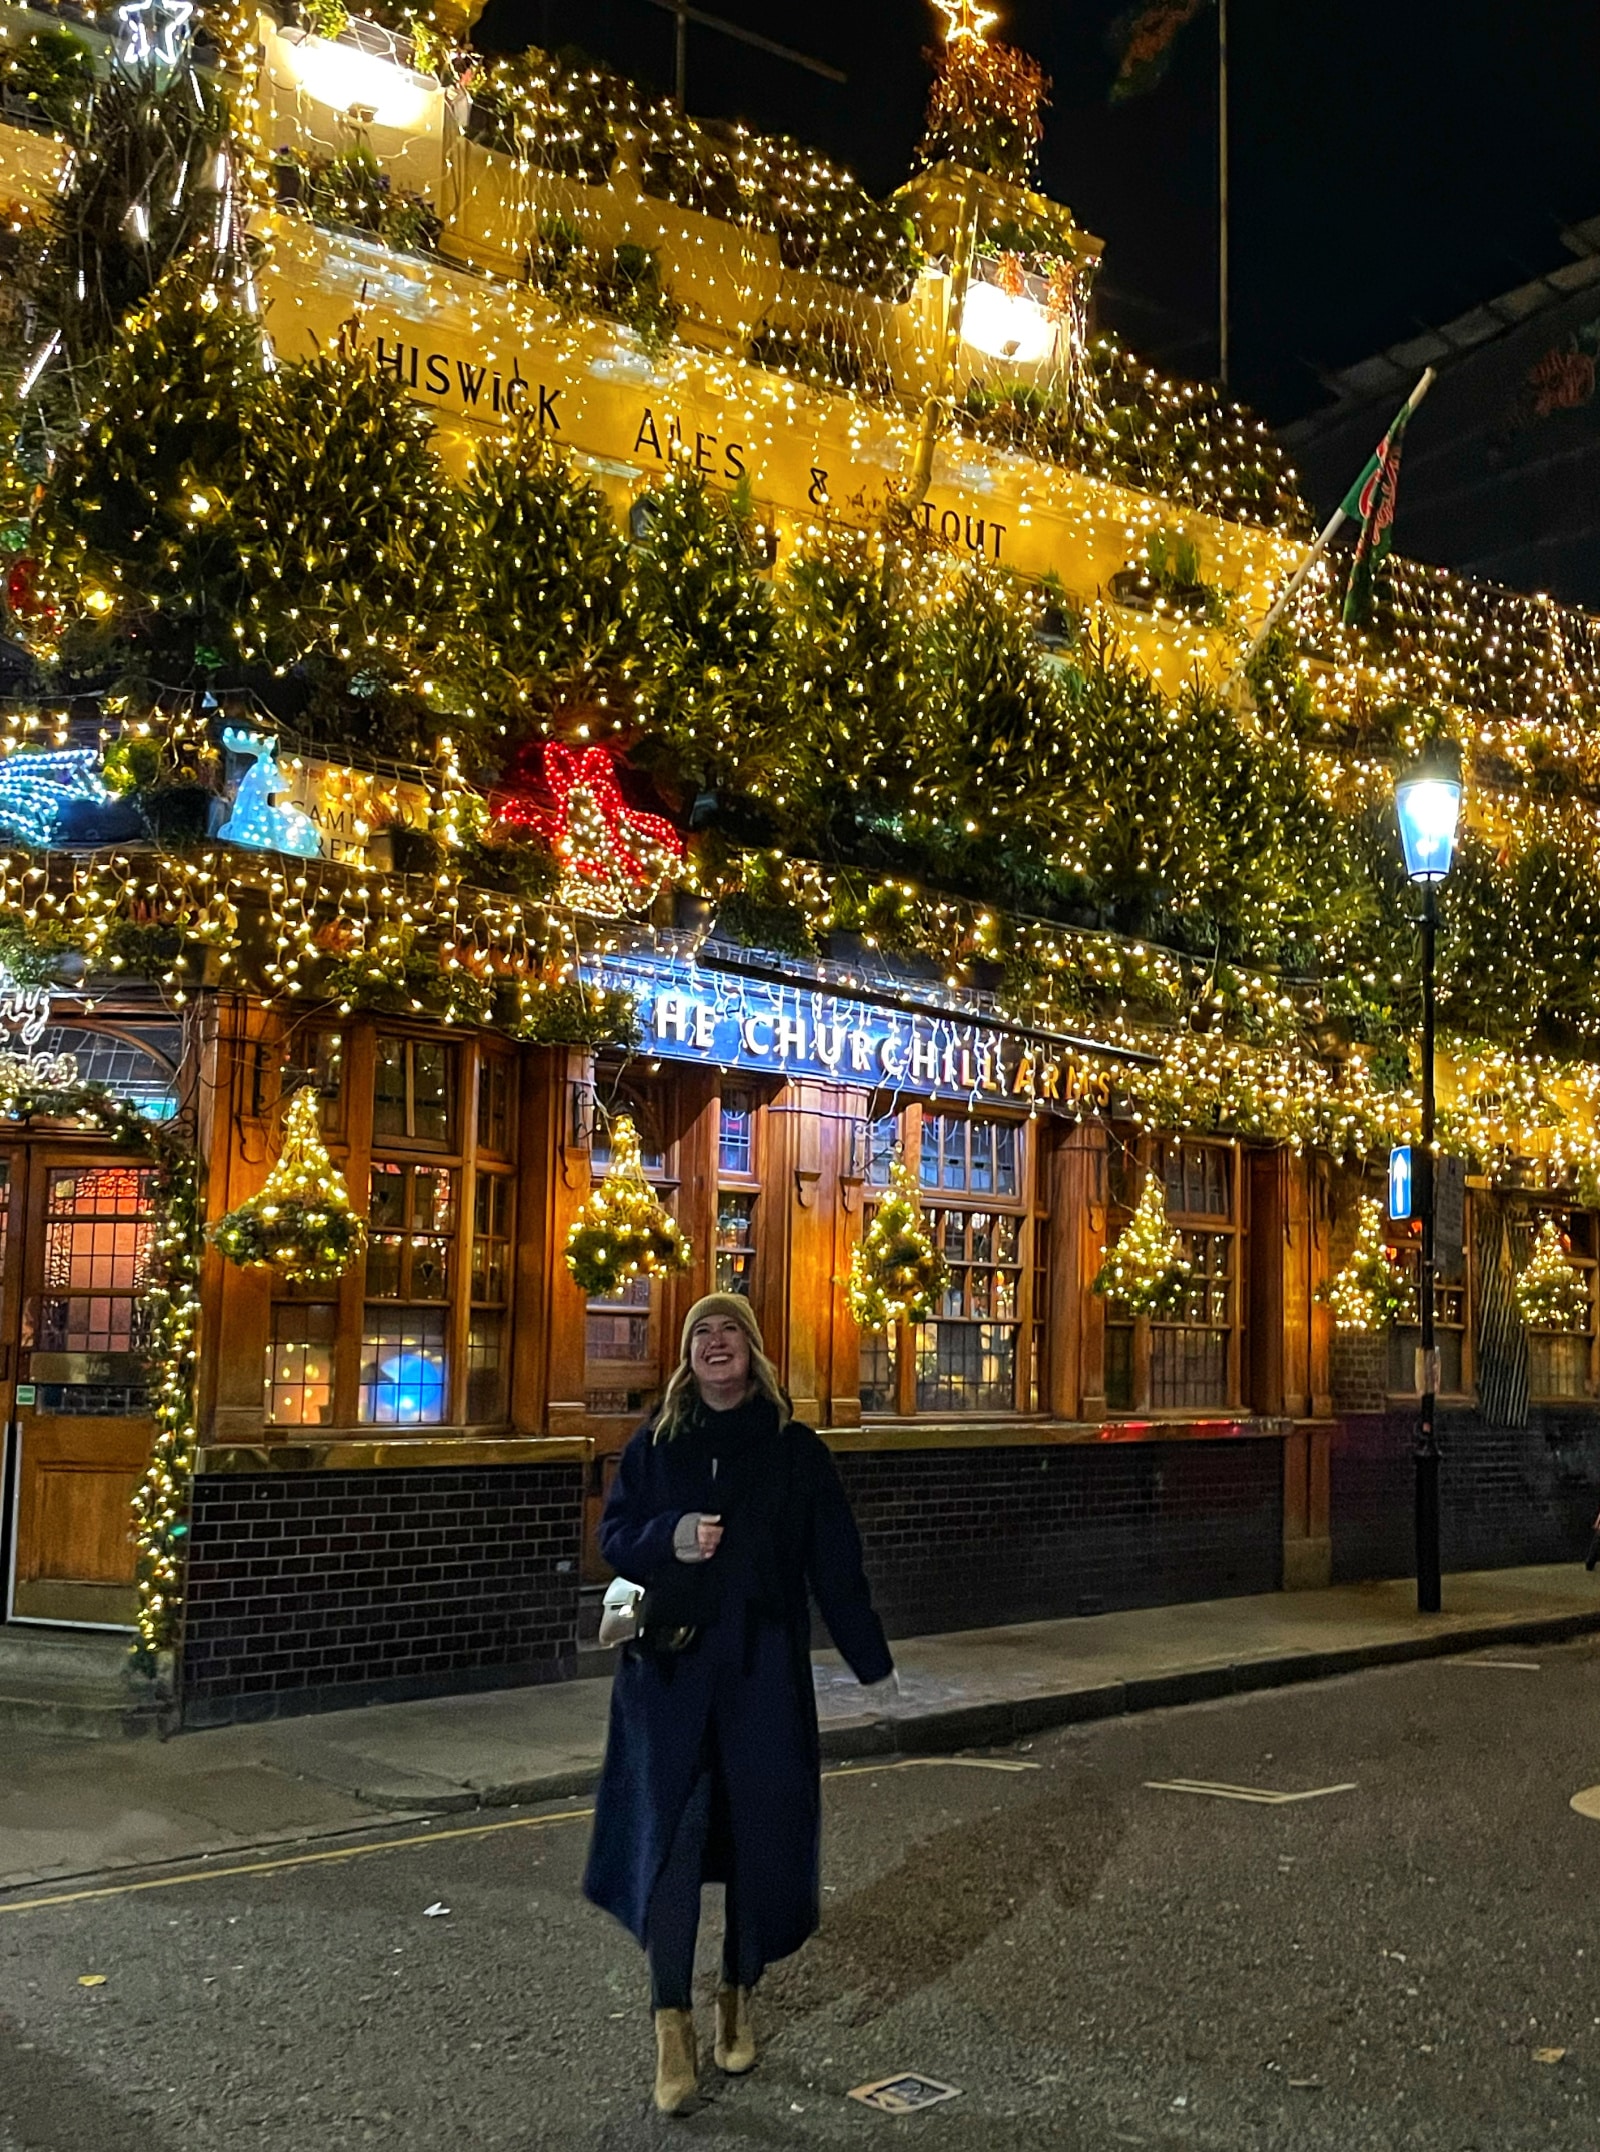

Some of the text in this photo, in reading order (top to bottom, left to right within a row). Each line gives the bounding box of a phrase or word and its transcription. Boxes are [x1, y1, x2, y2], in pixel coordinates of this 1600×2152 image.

[376, 336, 562, 430] HISWICK
[918, 500, 1008, 559] TOUT
[653, 994, 1111, 1108] HE CHURCHILL ARMS
